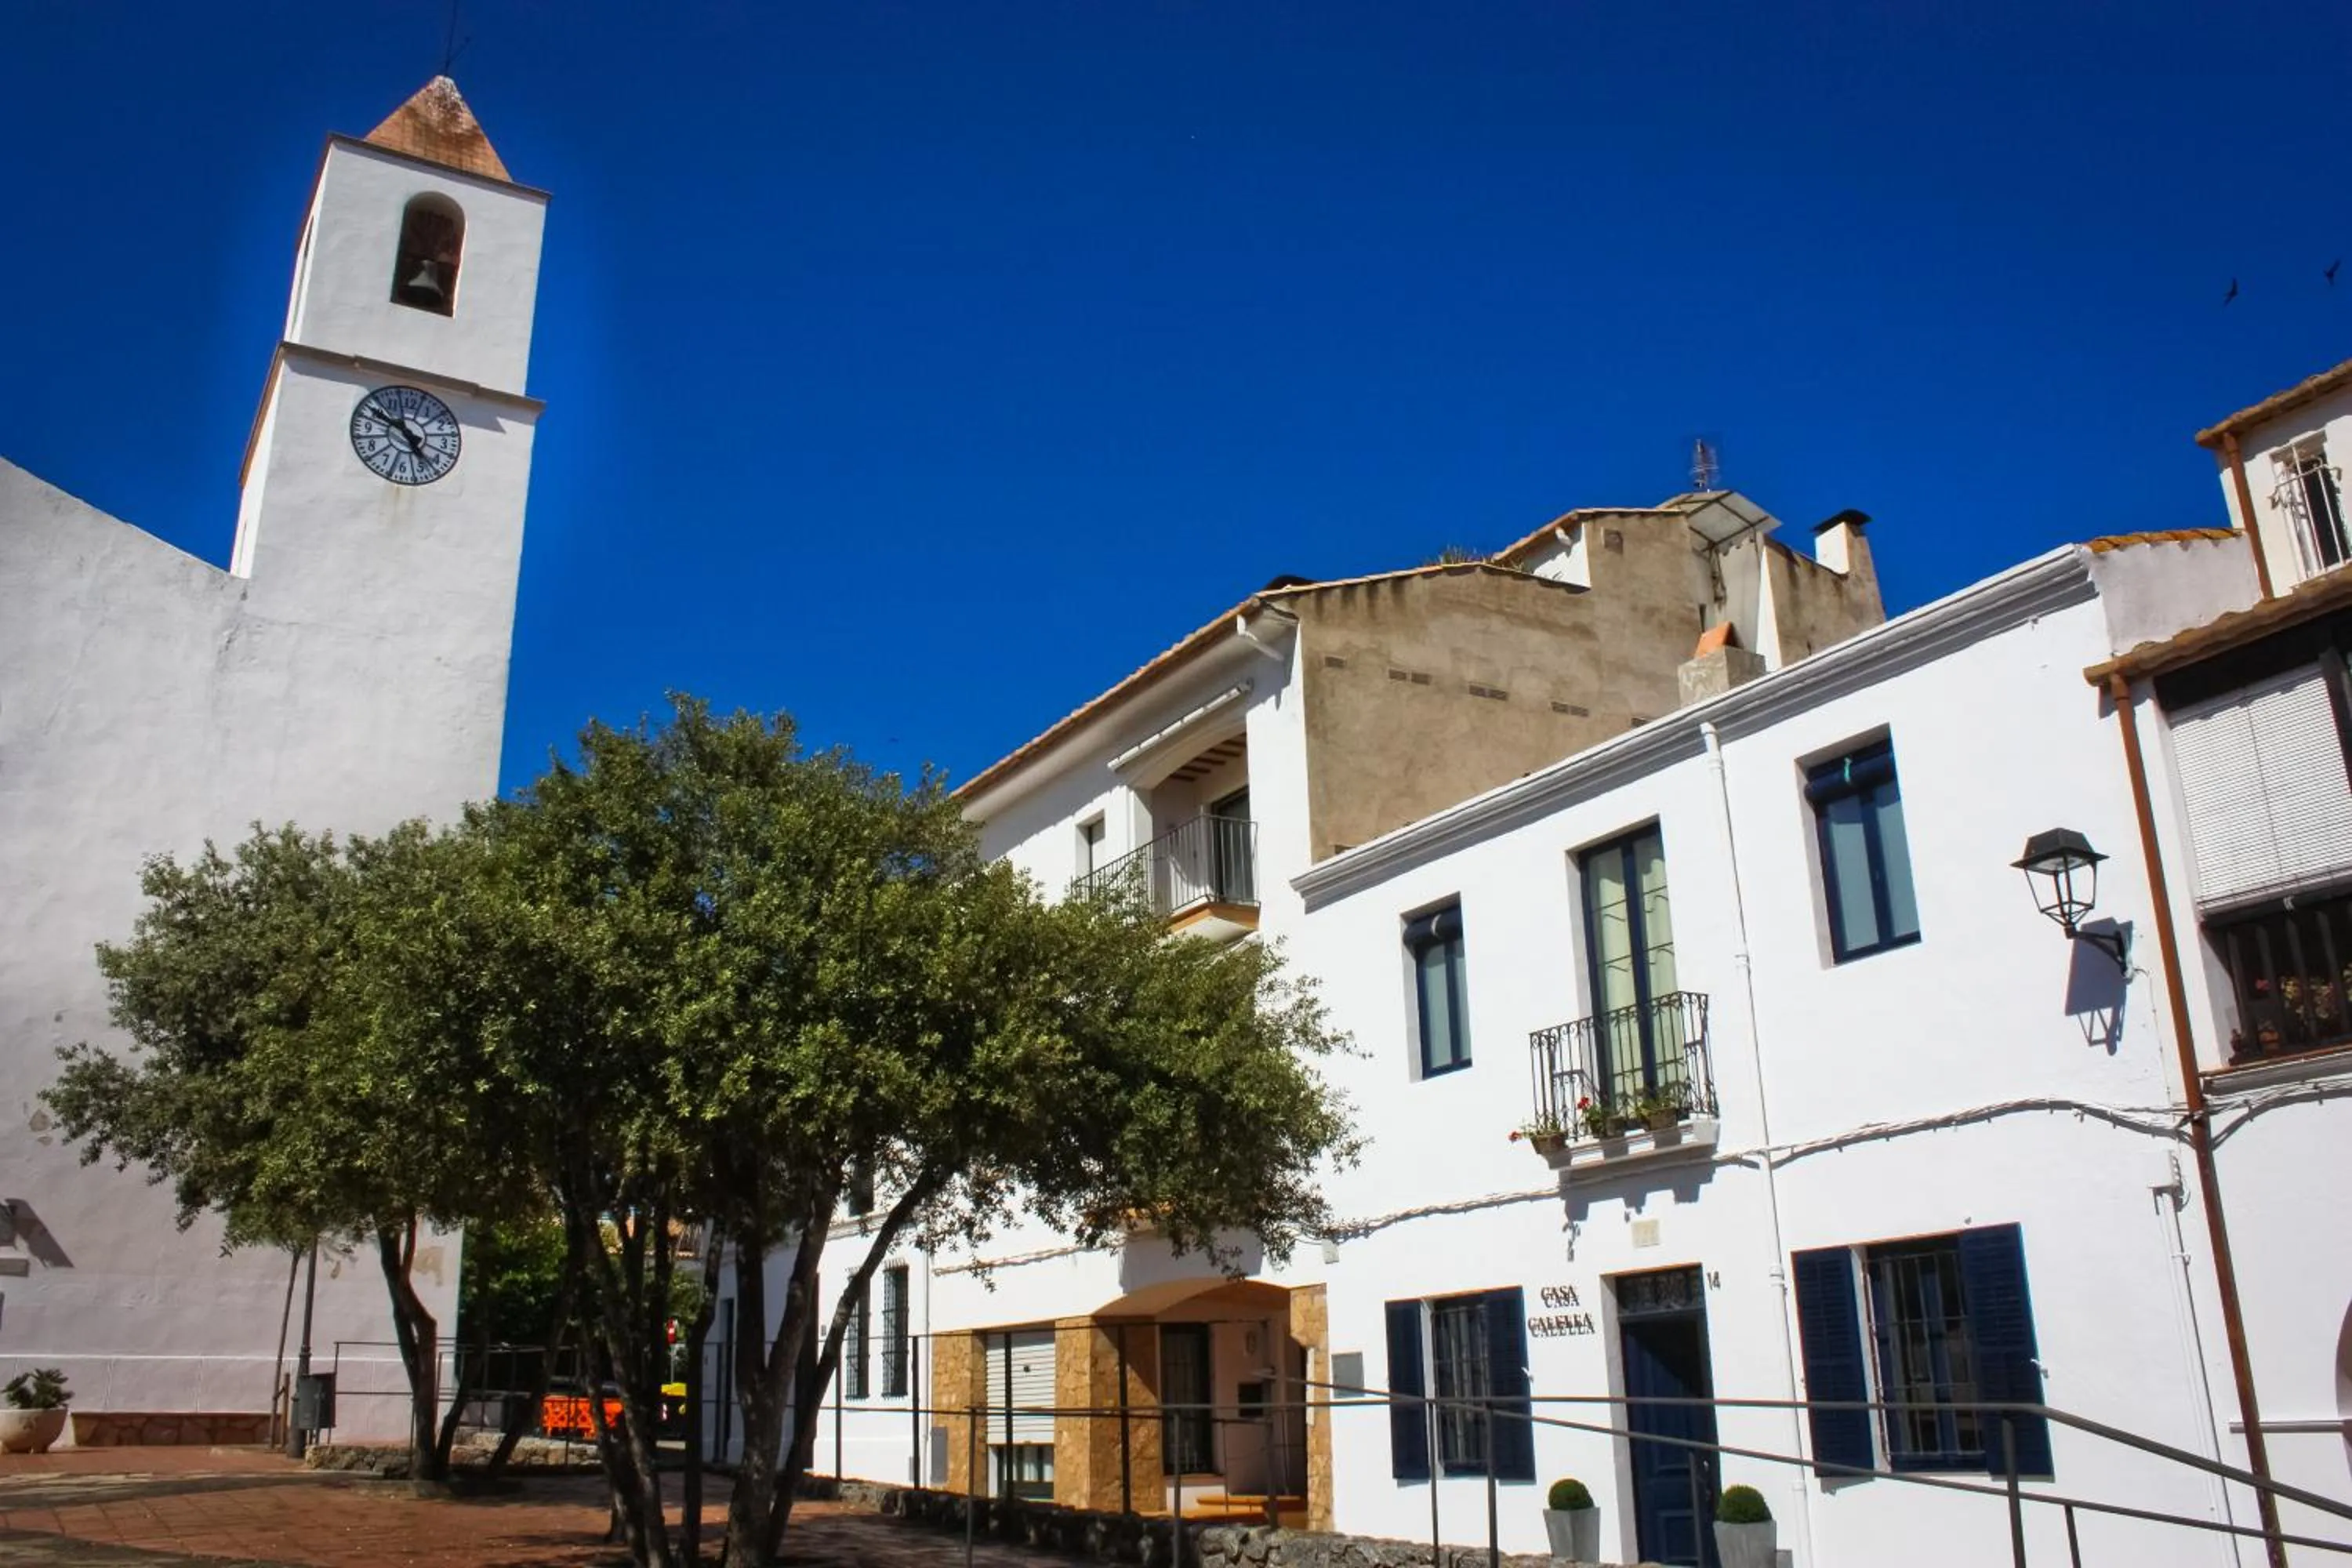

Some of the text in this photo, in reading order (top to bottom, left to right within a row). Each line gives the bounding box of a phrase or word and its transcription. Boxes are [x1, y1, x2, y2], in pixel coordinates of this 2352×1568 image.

[405, 397, 417, 409] 12
[365, 422, 372, 433] 9
[437, 419, 445, 431] 2
[368, 439, 376, 452] 8
[440, 437, 448, 449] 3
[383, 453, 390, 466] 7
[430, 454, 440, 465] 4
[399, 462, 407, 473] 6
[416, 463, 424, 473] 5
[1706, 1271, 1721, 1290] 14
[1541, 1285, 1578, 1304] CASA
[1528, 1312, 1594, 1334] CALELLA
